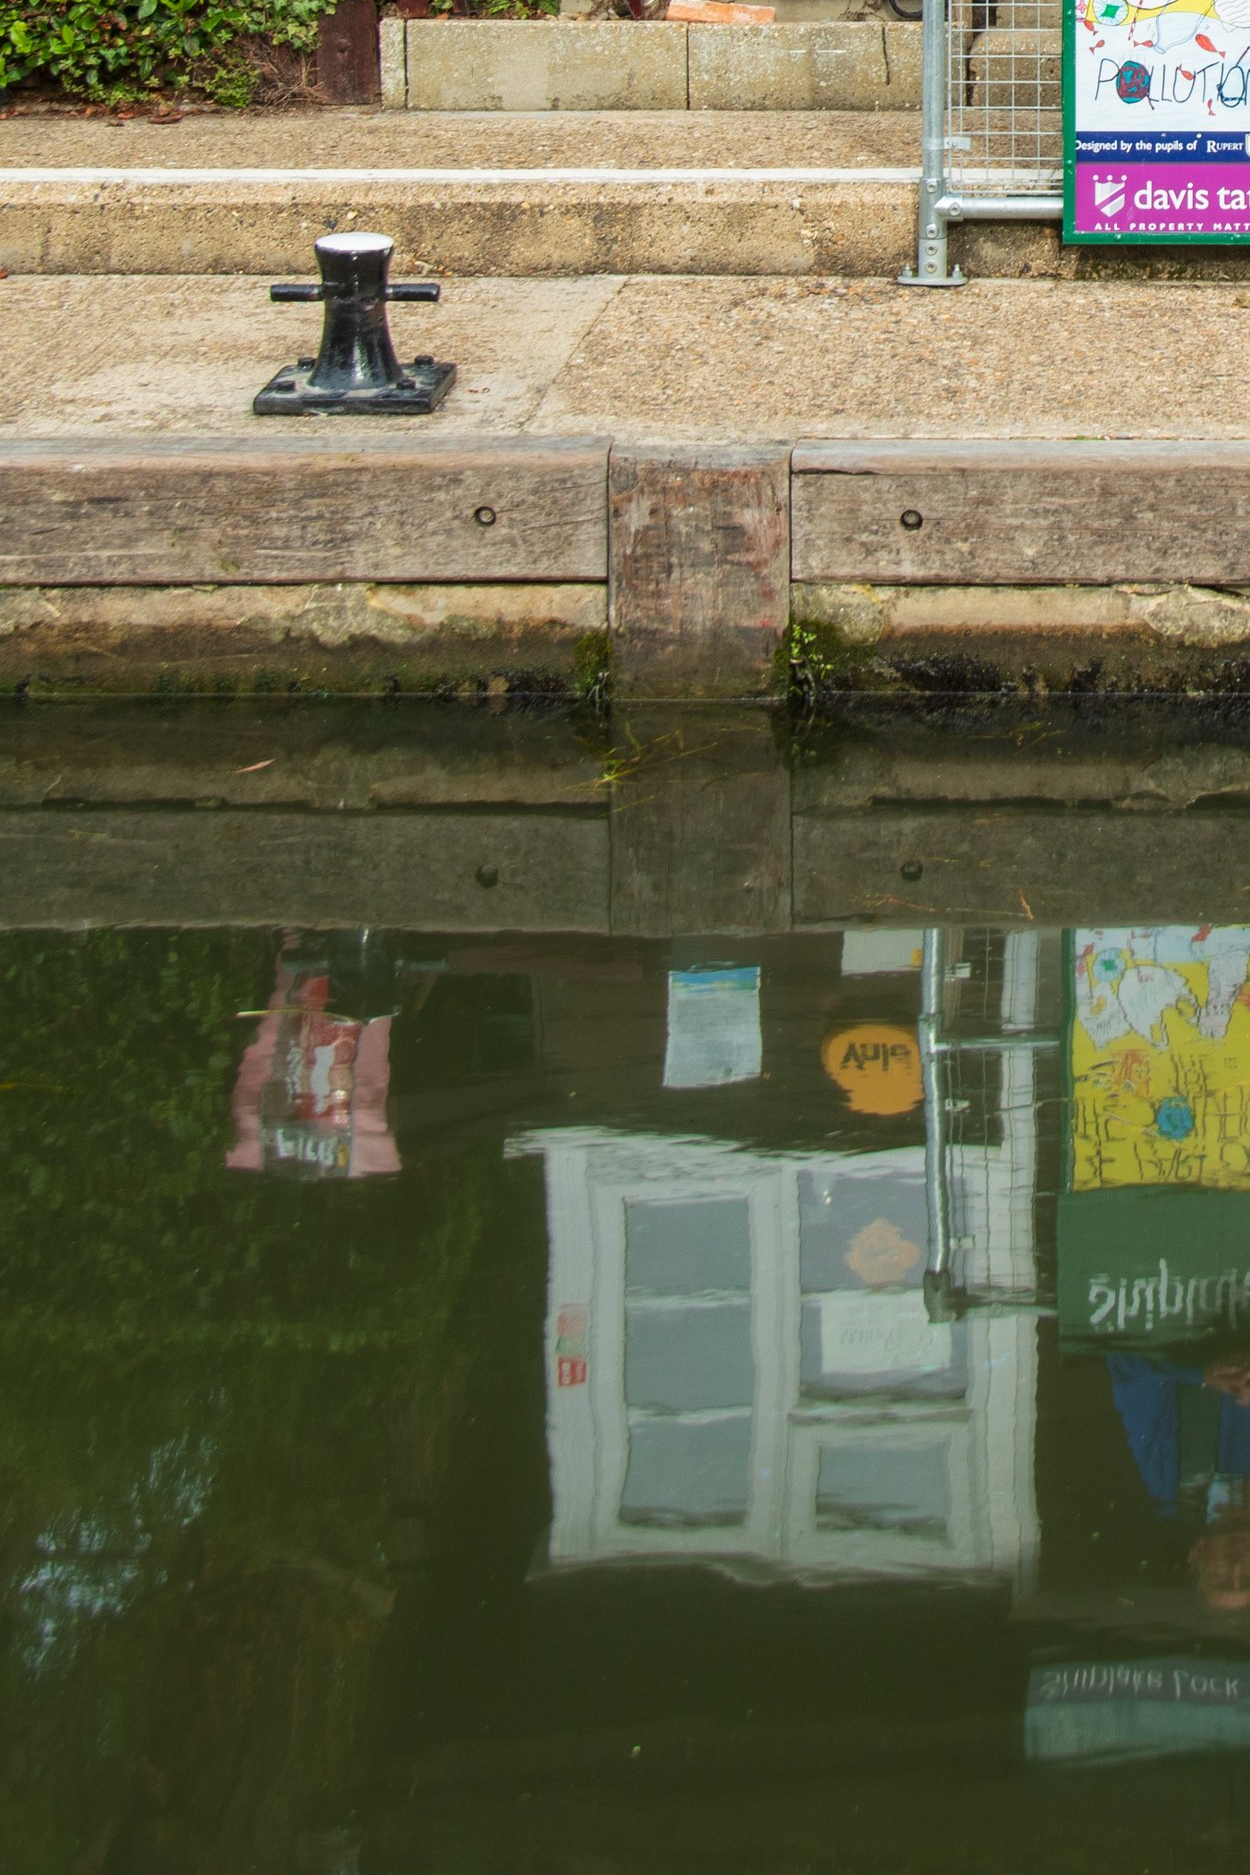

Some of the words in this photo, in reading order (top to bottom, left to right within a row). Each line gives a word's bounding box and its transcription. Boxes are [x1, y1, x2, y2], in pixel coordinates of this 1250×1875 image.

[1075, 139, 1118, 153] Designed
[1120, 140, 1133, 153] by
[1135, 140, 1152, 151] the
[1155, 140, 1184, 153] pupils
[1186, 140, 1198, 151] of
[1206, 140, 1244, 153] RUPERT
[1134, 180, 1209, 210] davis
[1094, 222, 1120, 231] ALL
[1129, 222, 1204, 231] PROPERTY
